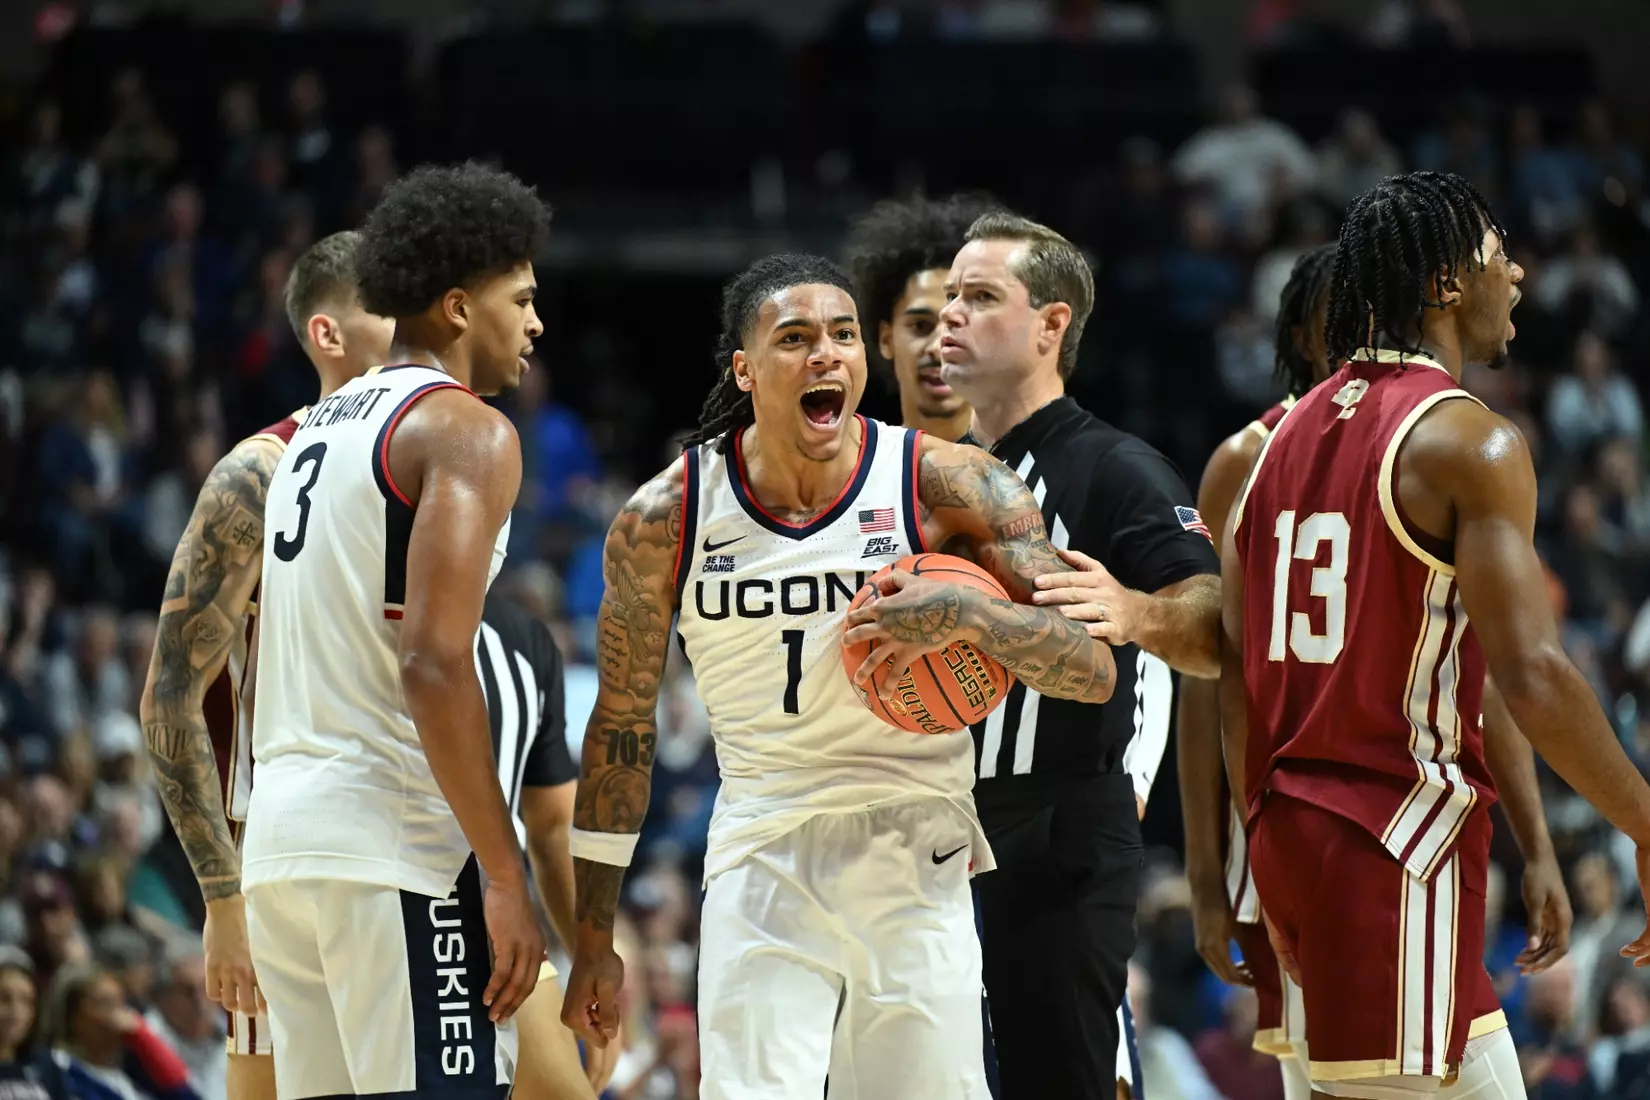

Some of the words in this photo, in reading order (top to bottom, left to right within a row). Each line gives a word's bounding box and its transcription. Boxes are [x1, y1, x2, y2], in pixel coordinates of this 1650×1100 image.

[299, 387, 392, 430] STEWART
[273, 442, 327, 562] 3
[706, 555, 717, 564] BE
[719, 555, 735, 564] THE
[863, 544, 899, 555] EAST
[867, 536, 892, 547] BIG
[702, 564, 735, 573] CHANGE
[1268, 510, 1351, 664] 13
[695, 570, 877, 621] UCON
[781, 629, 805, 715] 1
[886, 653, 956, 735] SPALDIN
[604, 727, 657, 768] 703
[428, 884, 475, 1076] USKIES
